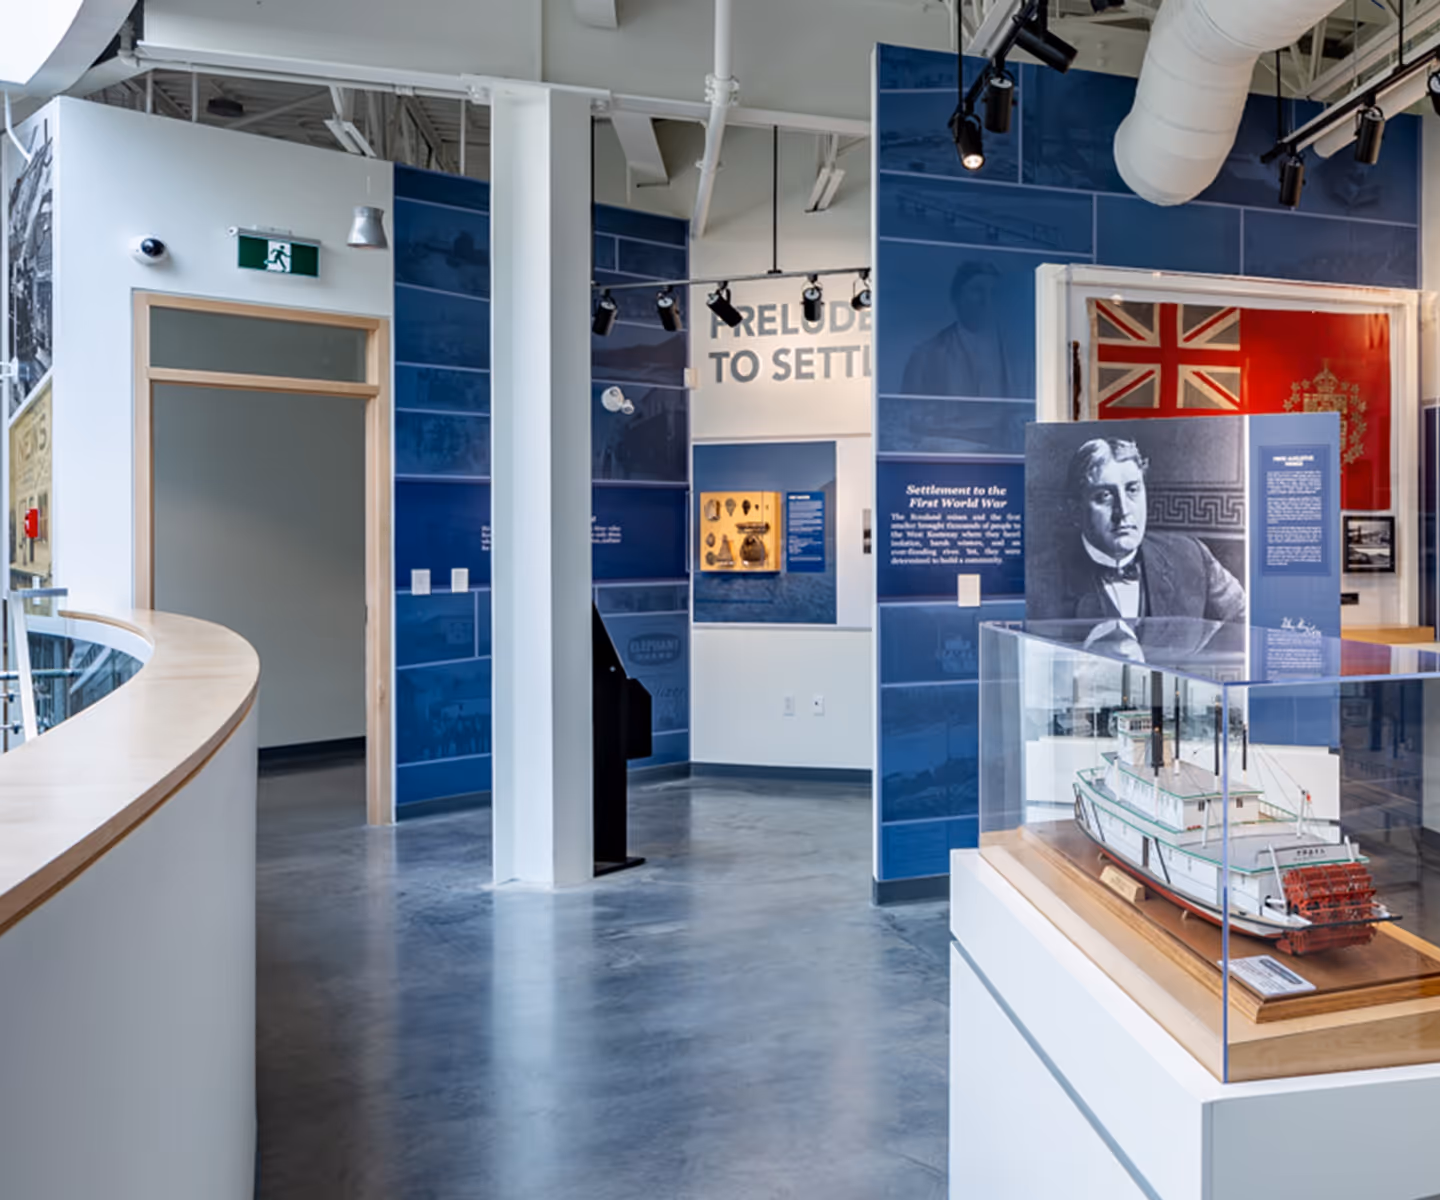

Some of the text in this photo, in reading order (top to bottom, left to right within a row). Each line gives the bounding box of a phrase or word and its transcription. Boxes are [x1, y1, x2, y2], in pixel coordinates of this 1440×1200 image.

[708, 349, 760, 383] TO
[906, 485, 1007, 496] Settlement to the
[909, 498, 1008, 508] First World War
[890, 531, 902, 539] the
[984, 531, 1000, 539] they
[991, 539, 1005, 547] and
